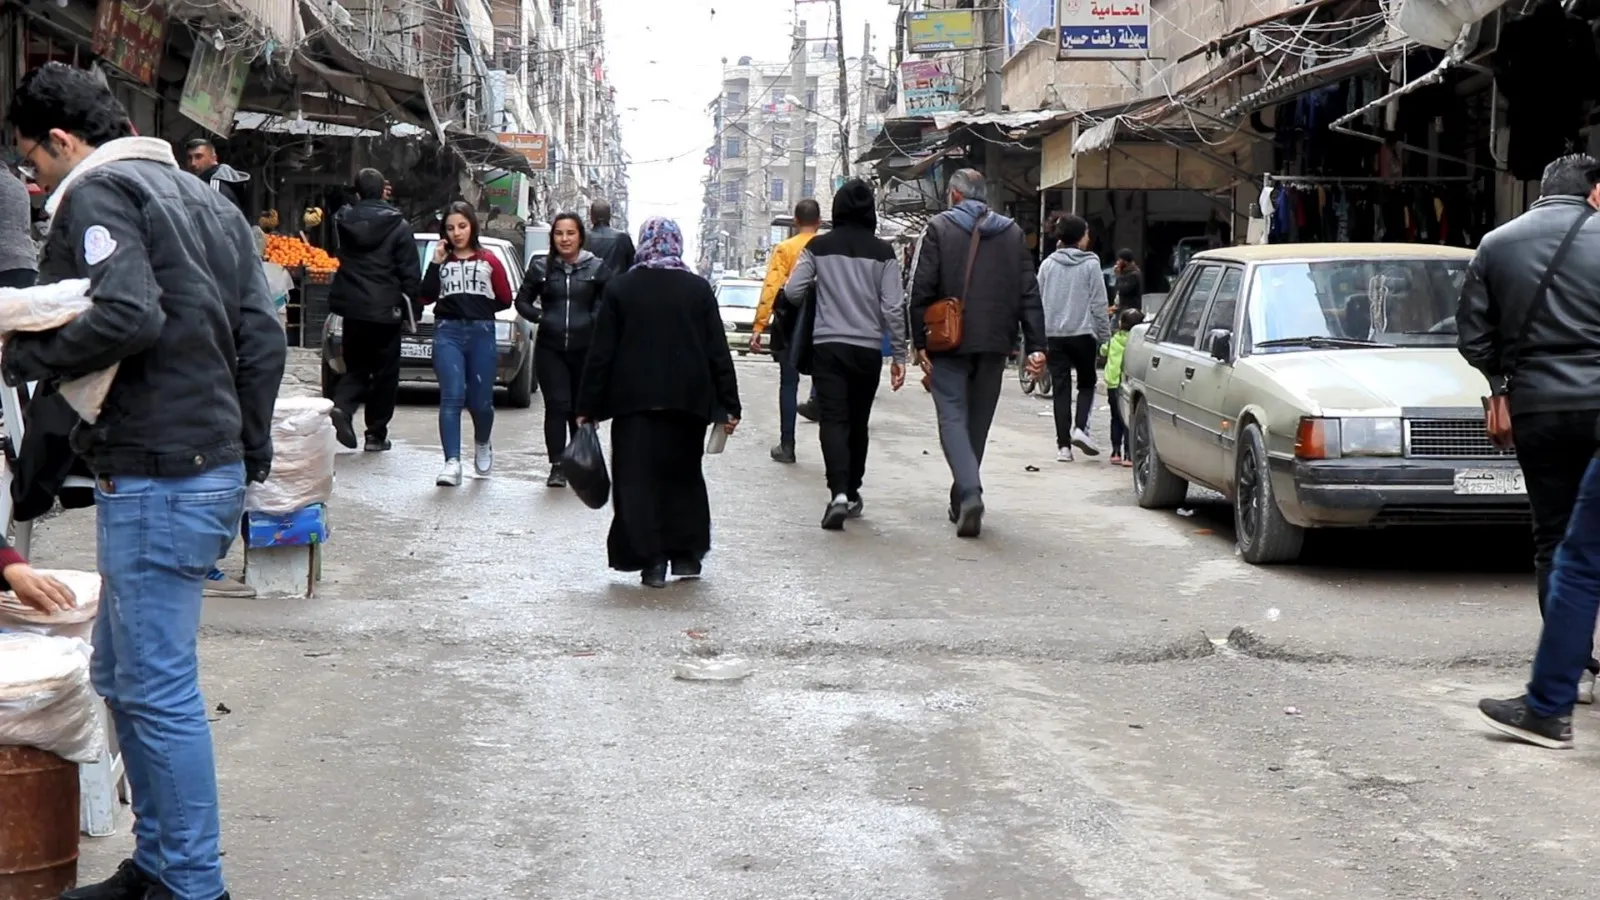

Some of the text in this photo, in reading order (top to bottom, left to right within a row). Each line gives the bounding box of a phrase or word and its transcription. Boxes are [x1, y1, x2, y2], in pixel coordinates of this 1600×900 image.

[1090, 1, 1144, 20] المحامية
[1061, 28, 1146, 49] سهيلة رفعت حسين
